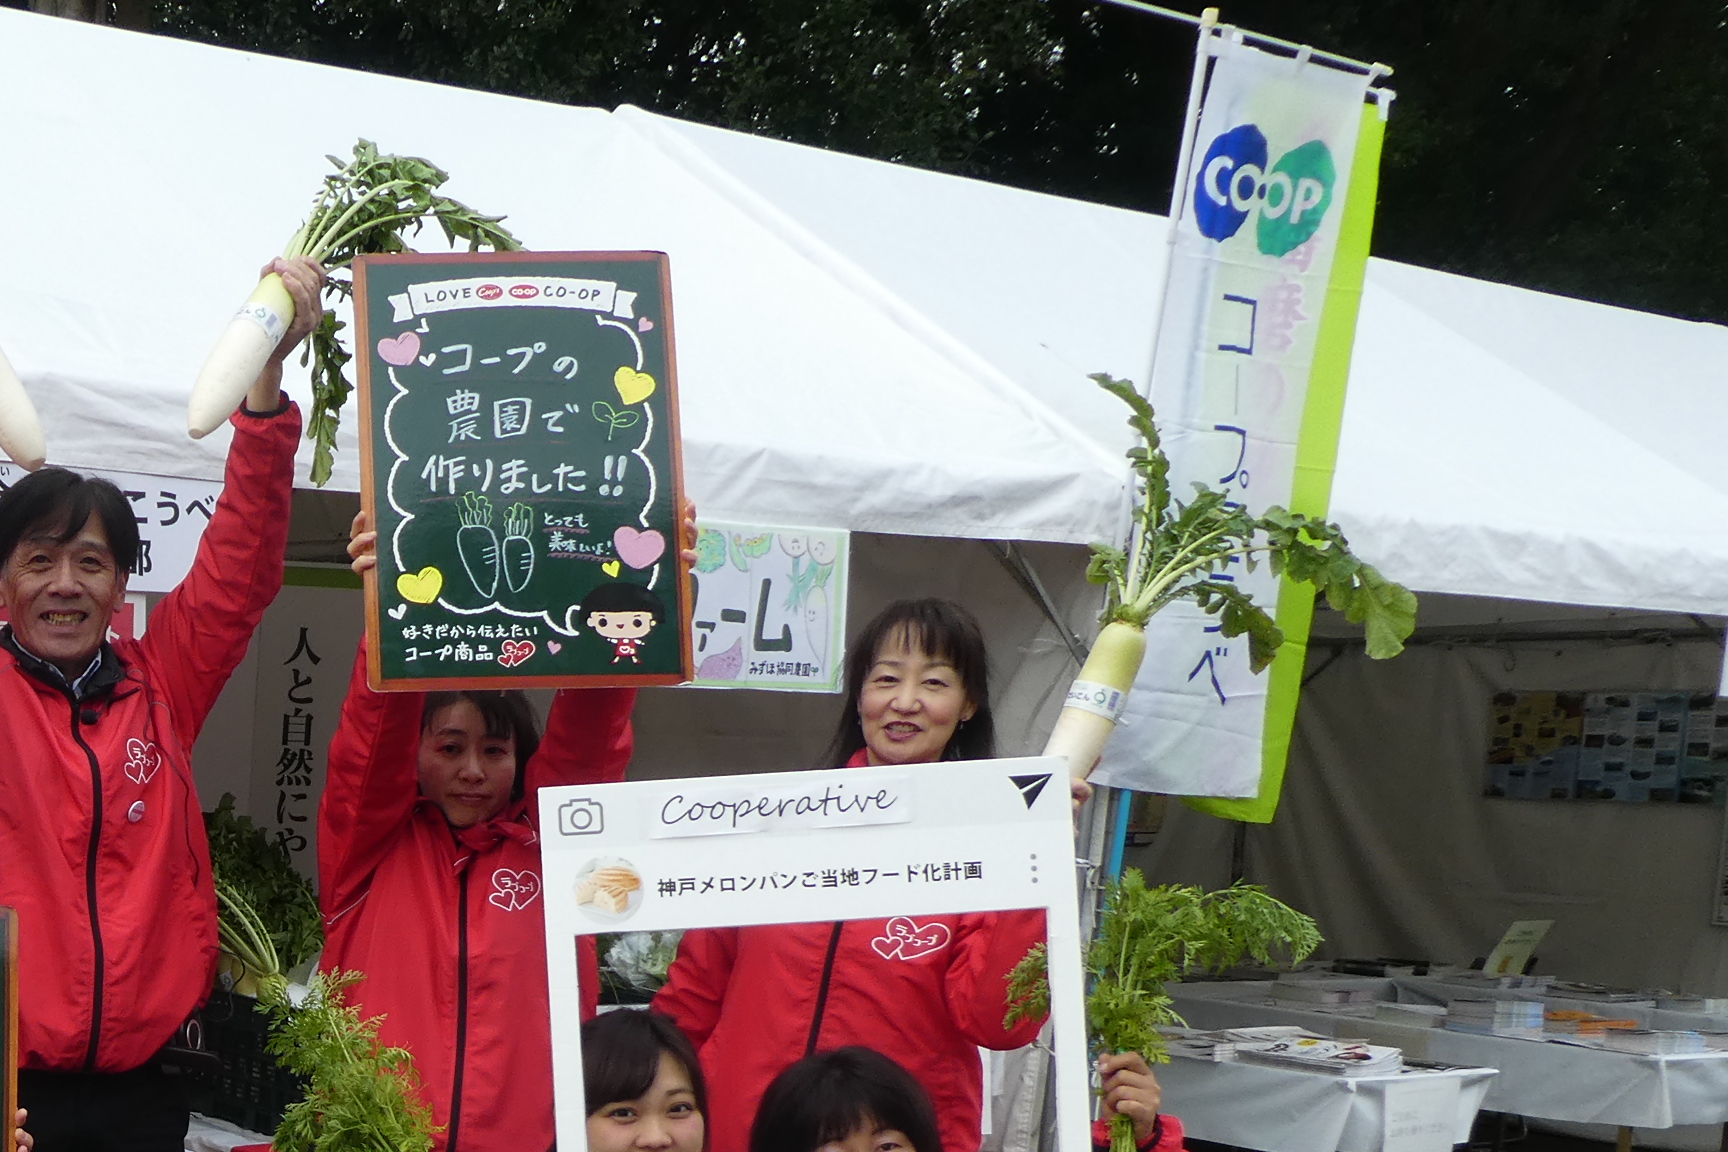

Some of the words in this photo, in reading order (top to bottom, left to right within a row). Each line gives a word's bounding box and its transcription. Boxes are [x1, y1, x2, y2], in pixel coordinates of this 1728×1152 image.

[424, 288, 472, 303] LOVE
[543, 285, 601, 302] CO-OP
[440, 342, 579, 380] コープの
[446, 389, 580, 444] 農園で
[544, 512, 589, 528] とっても
[402, 623, 538, 640] 好きだから伝えたい
[405, 642, 494, 662] コープ商品
[660, 784, 898, 828] Cooperative
[657, 860, 983, 898] 神戸メロンパンご当地フード化計画
